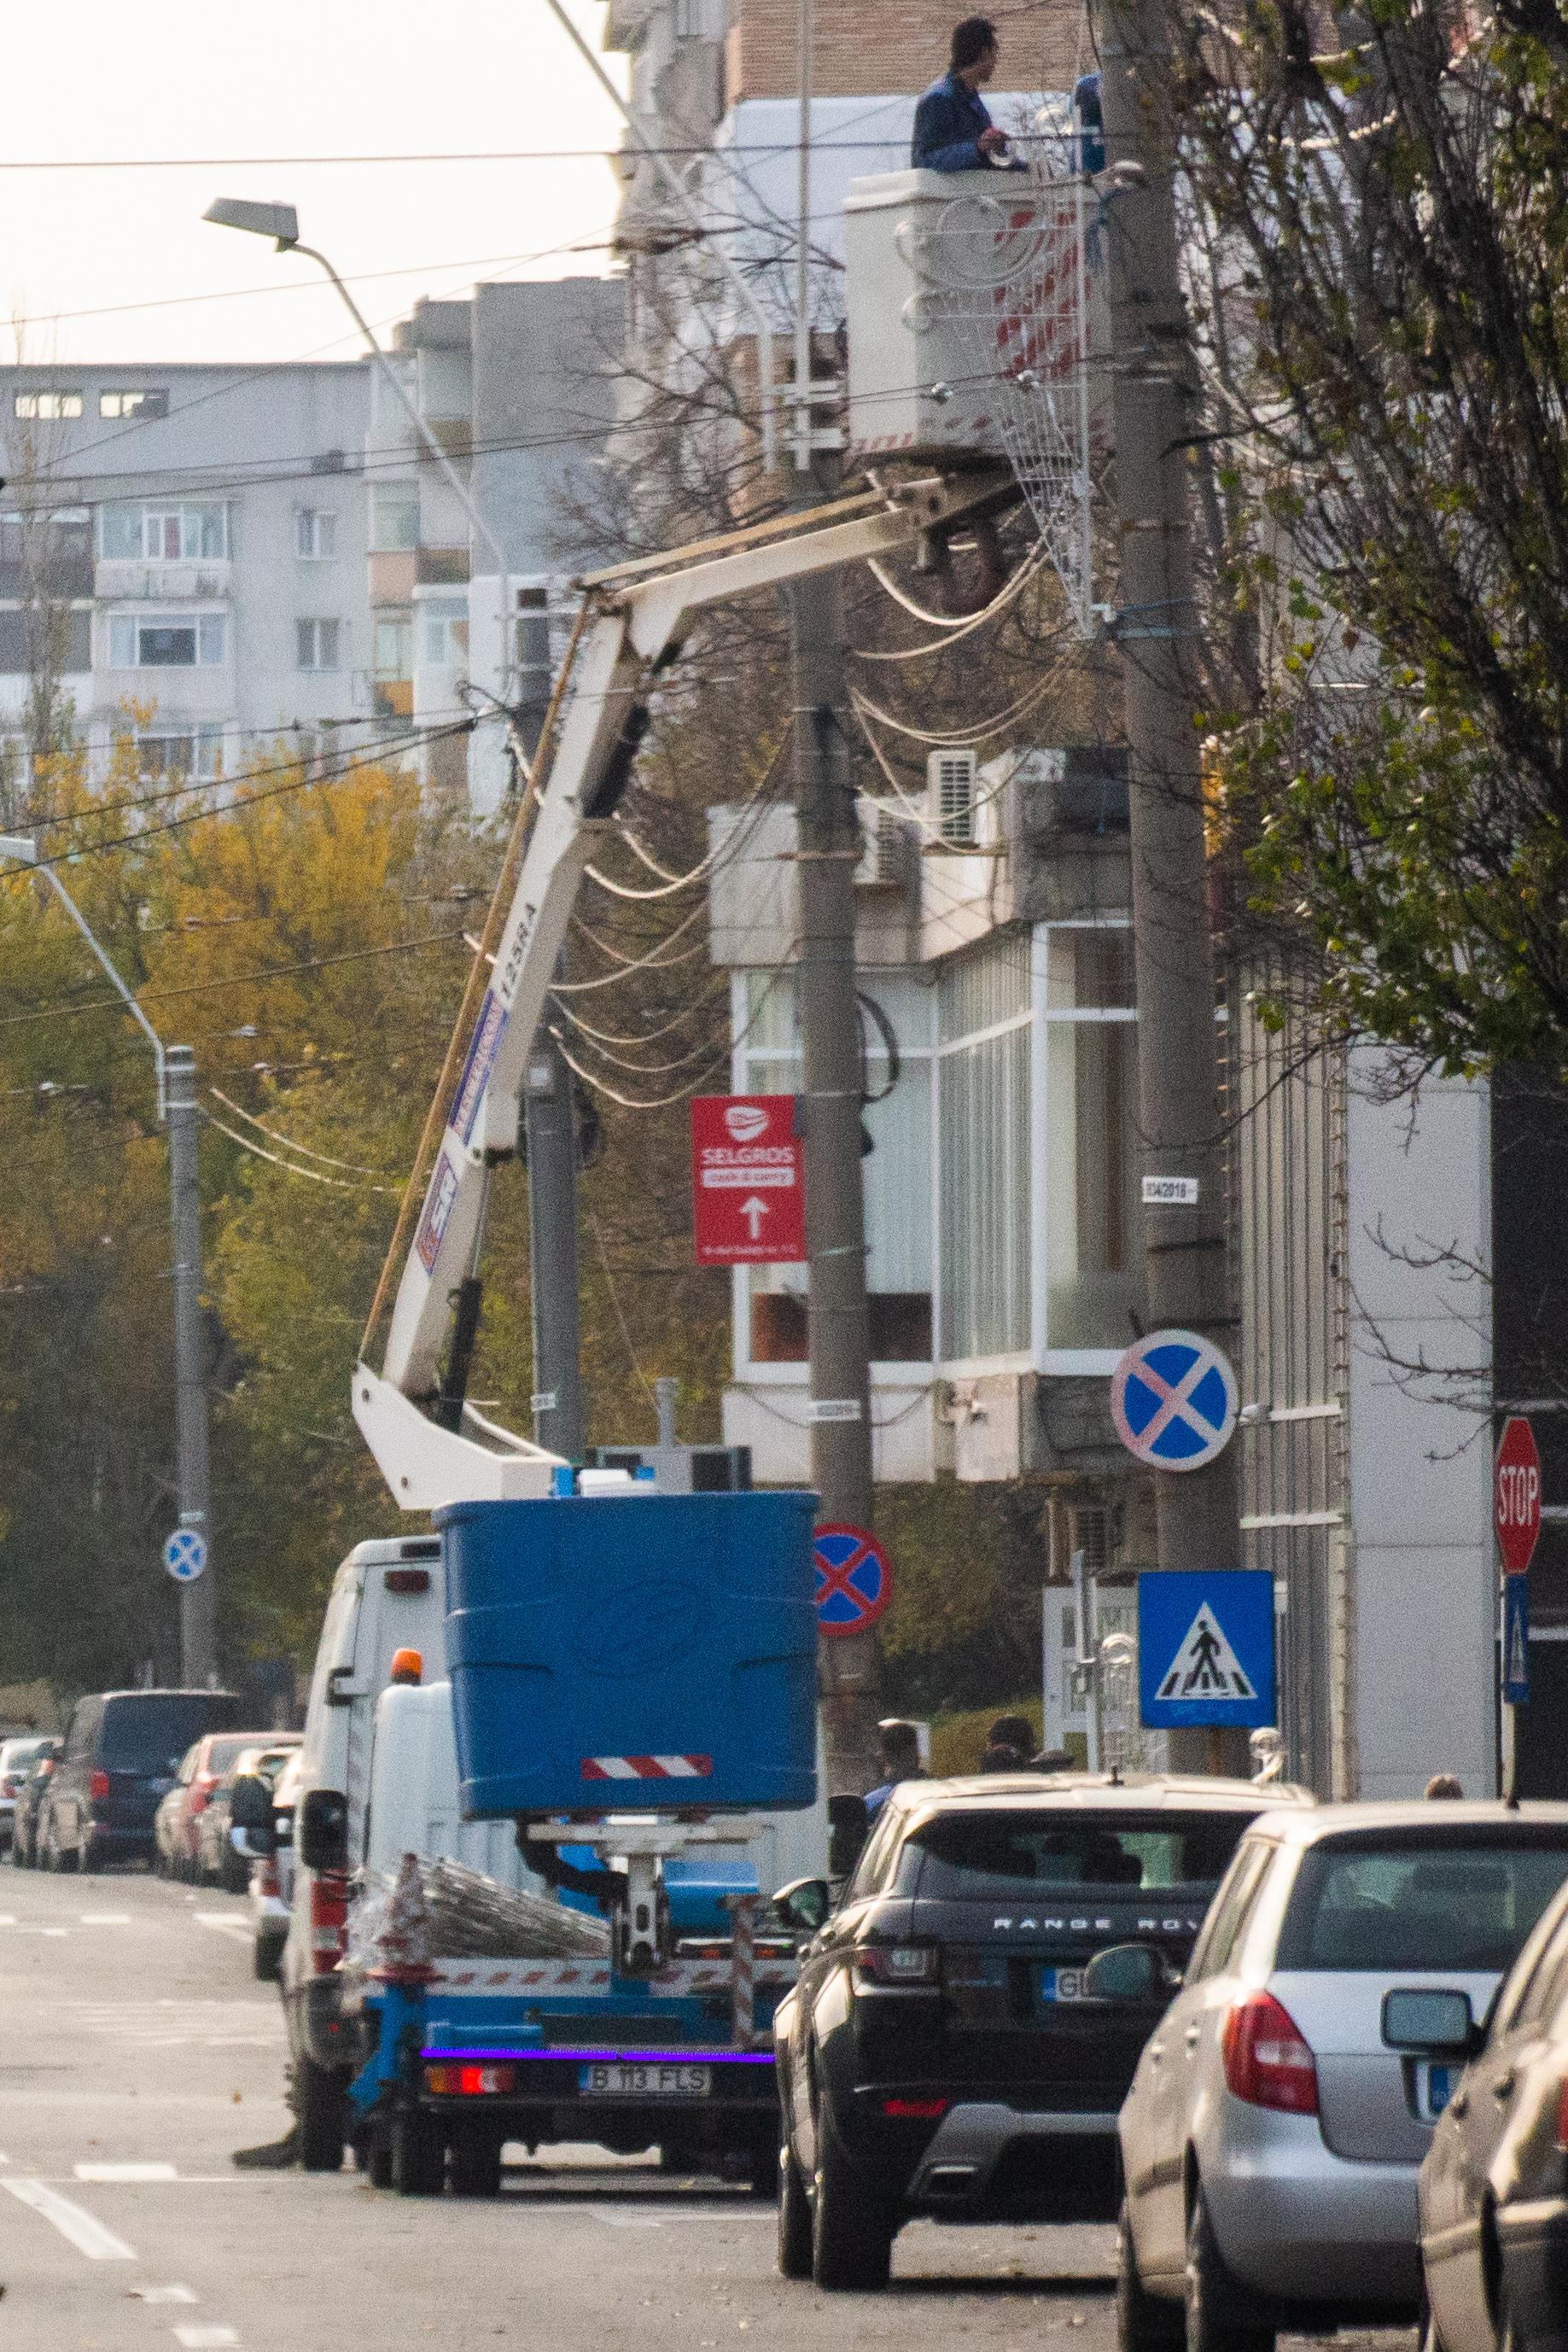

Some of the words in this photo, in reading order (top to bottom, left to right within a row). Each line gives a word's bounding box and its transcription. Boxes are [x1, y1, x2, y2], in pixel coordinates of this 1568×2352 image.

[702, 1146, 795, 1165] SELGROS
[1498, 1465, 1536, 1526] STOP
[993, 1917, 1110, 1929] RANGE
[592, 2068, 609, 2089] B
[659, 2068, 705, 2090] FLS
